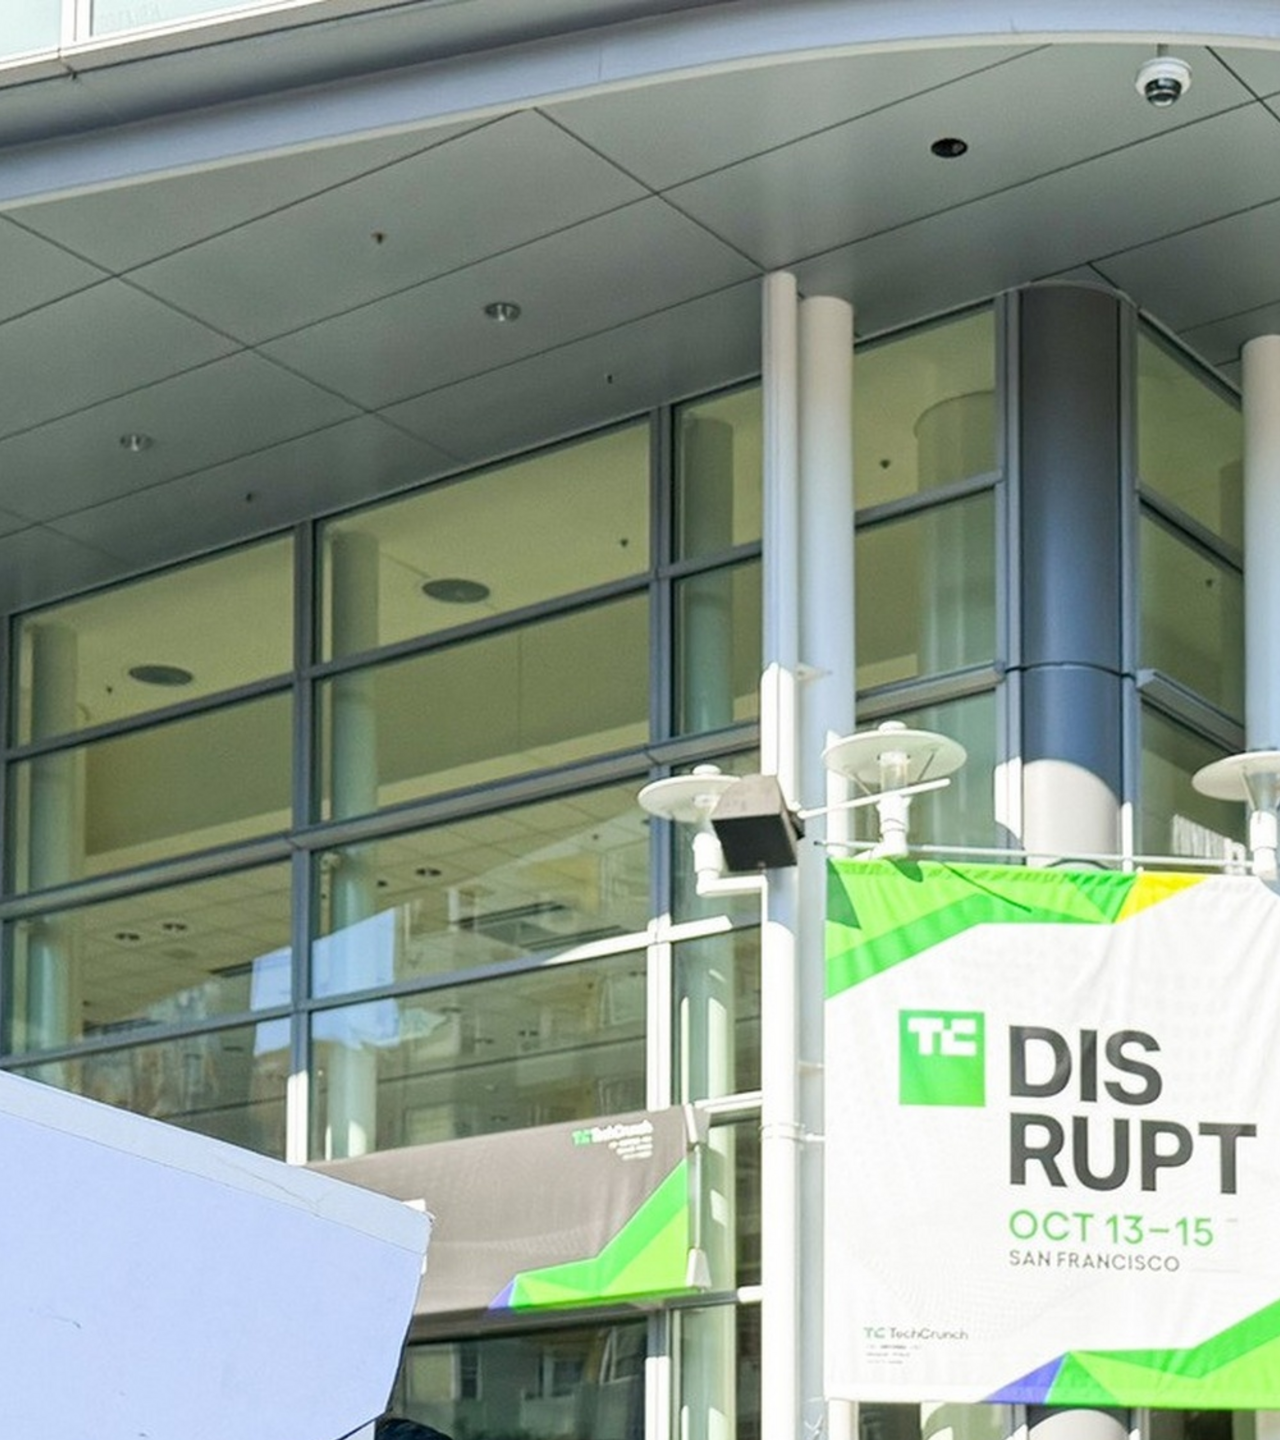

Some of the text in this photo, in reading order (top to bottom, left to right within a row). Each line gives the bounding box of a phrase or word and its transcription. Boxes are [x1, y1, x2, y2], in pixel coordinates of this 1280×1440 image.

[907, 1017, 977, 1056] TC
[1008, 1024, 1163, 1106] DIS
[1008, 1112, 1258, 1196] RUPT
[1009, 1209, 1094, 1242] OCT
[1009, 1249, 1180, 1272] SAN FRANCISCO
[889, 1326, 968, 1340] TechCrunch
